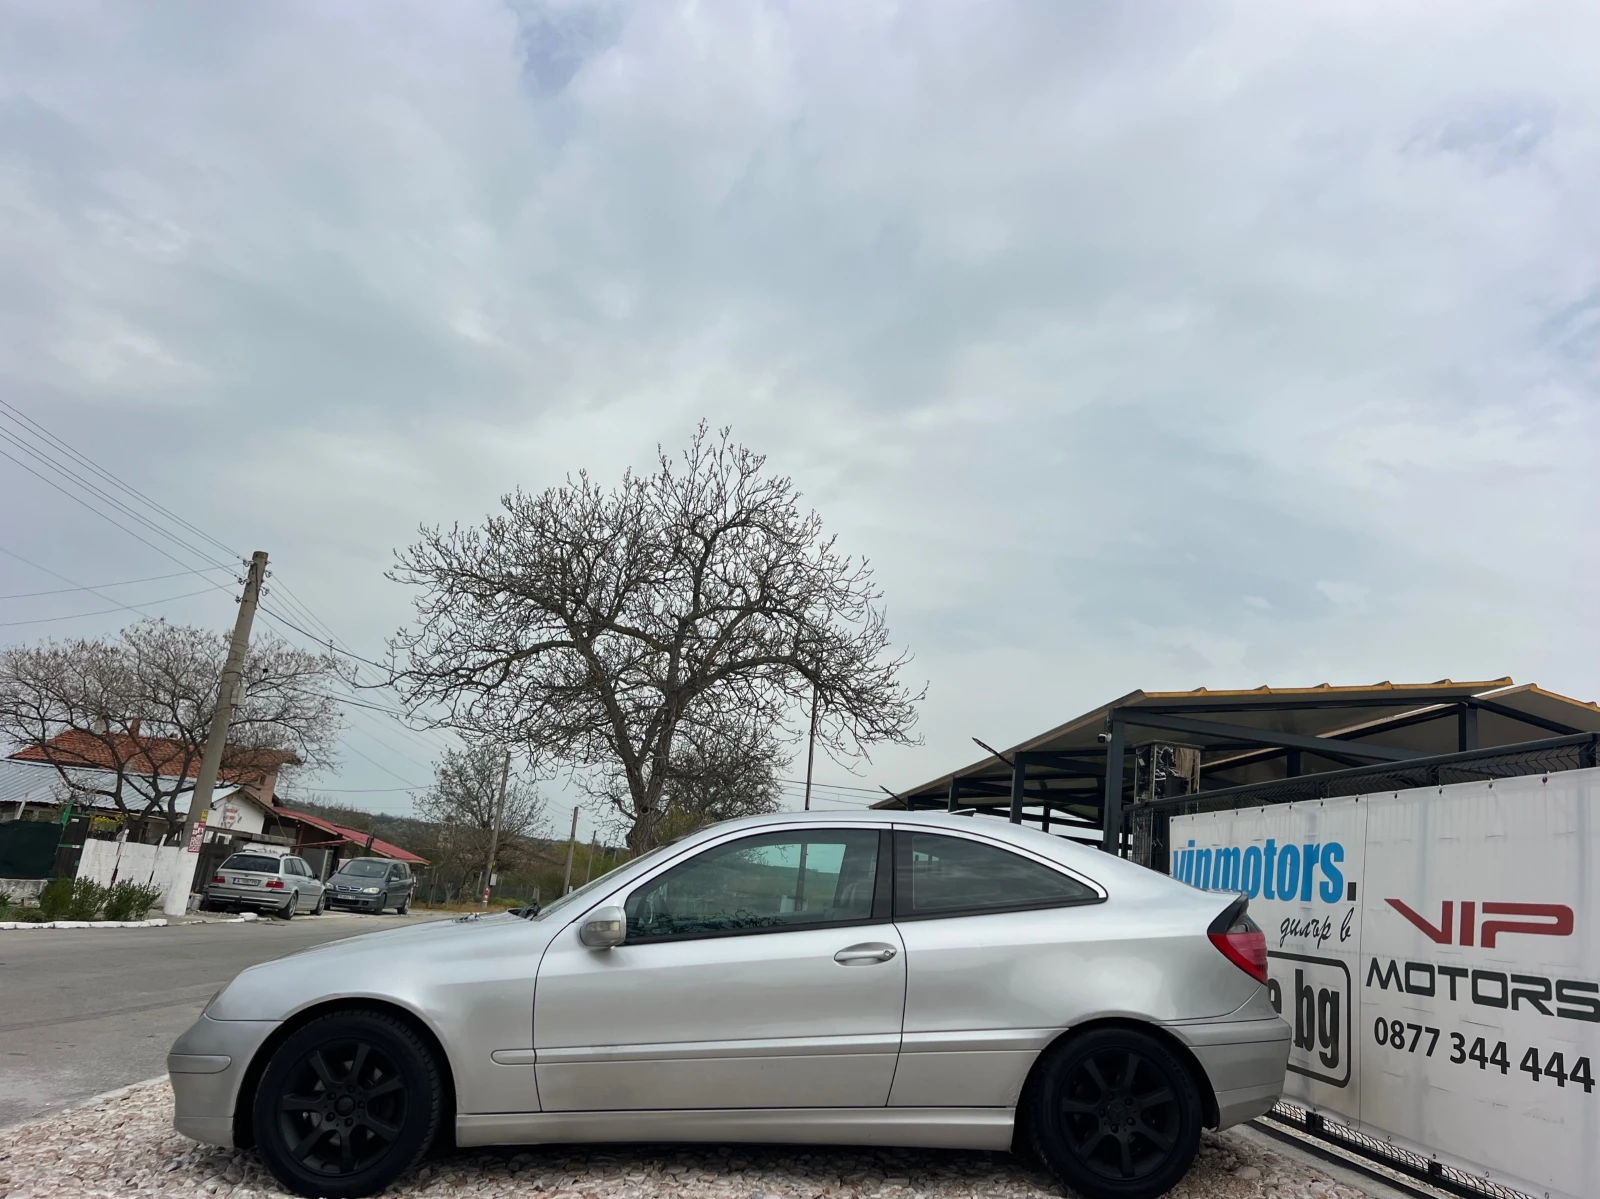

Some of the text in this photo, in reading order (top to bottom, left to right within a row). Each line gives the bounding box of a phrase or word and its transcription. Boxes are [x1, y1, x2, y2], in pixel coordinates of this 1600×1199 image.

[1384, 898, 1574, 949] VIP
[1365, 957, 1600, 1024] MOTORS
[1373, 1016, 1596, 1094] 0877 344 444
